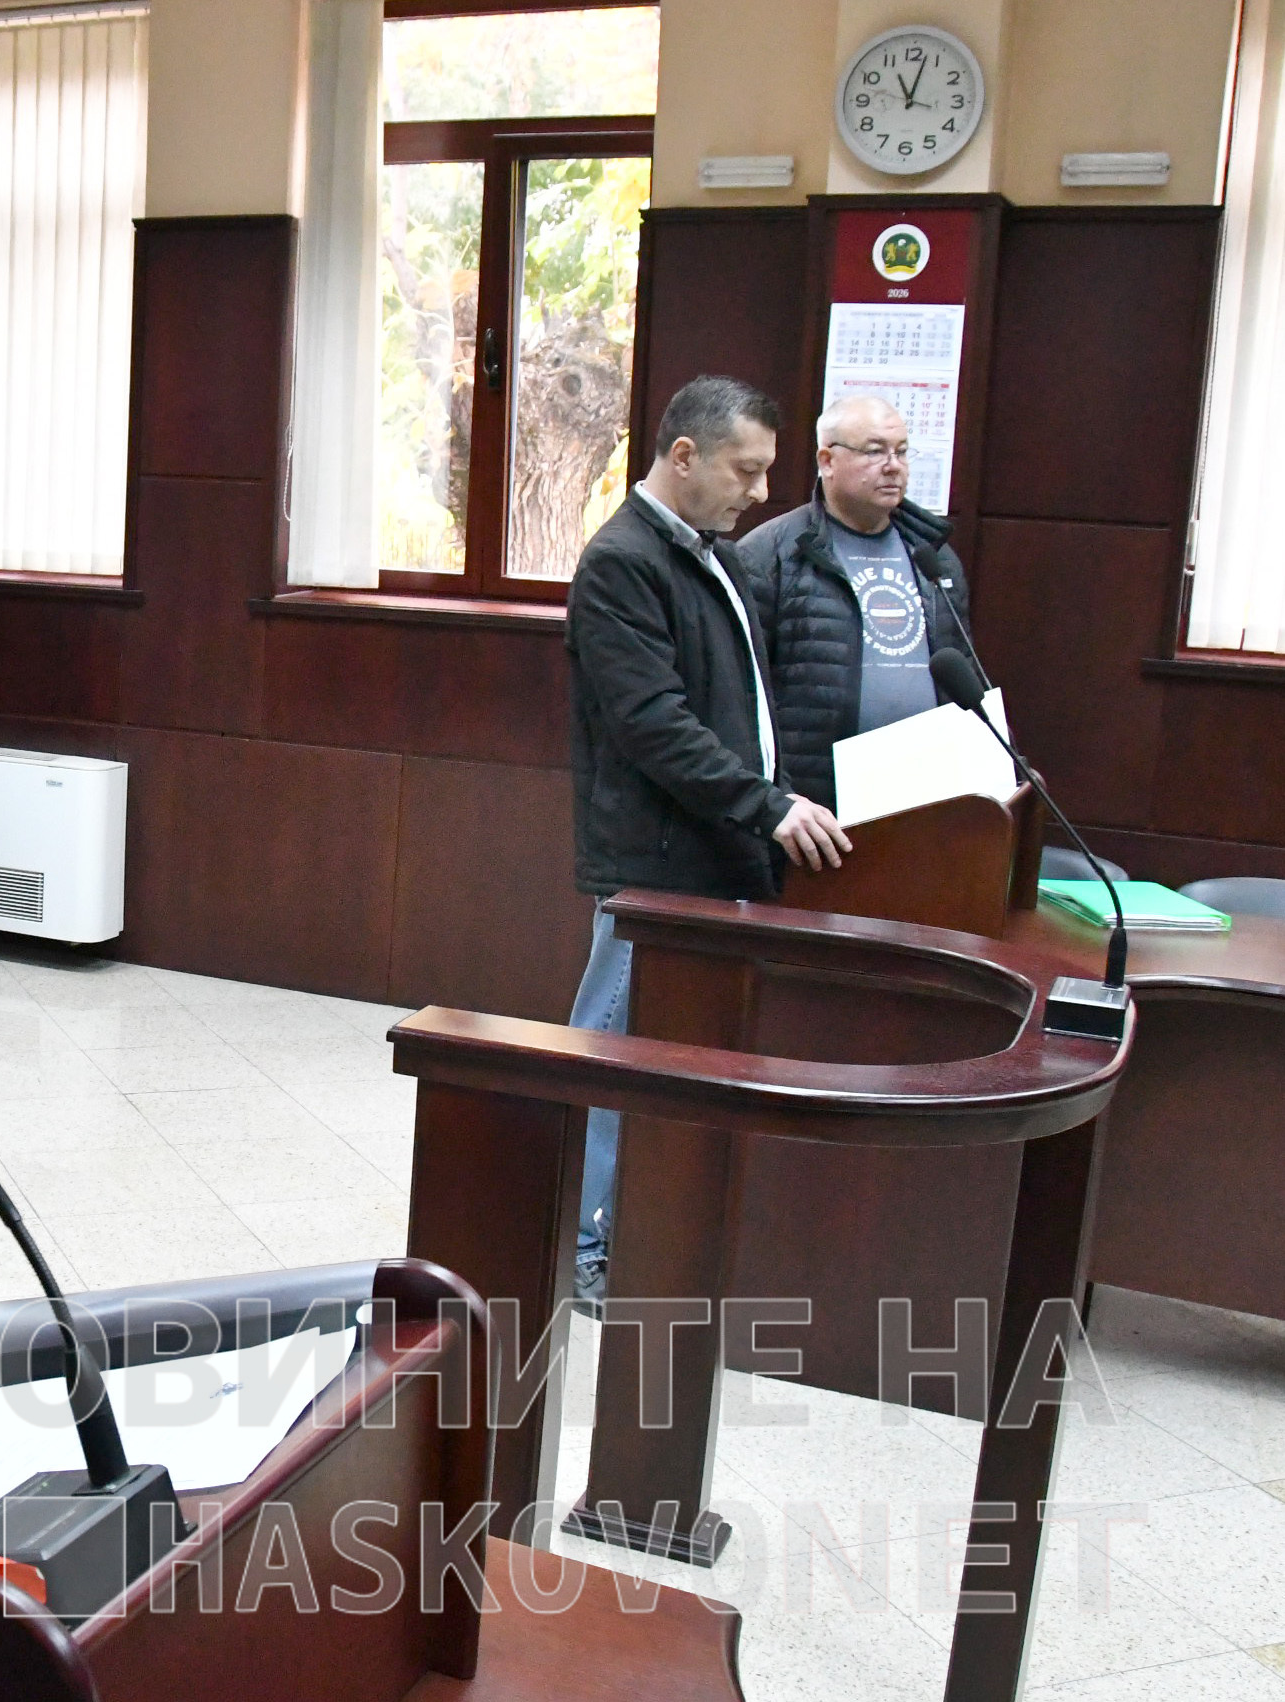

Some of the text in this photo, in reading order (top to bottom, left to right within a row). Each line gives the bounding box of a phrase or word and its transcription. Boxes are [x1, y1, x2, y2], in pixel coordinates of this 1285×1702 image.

[884, 54, 896, 68] 11
[905, 47, 923, 61] 12
[863, 71, 880, 85] 10
[946, 71, 960, 86] 2
[855, 94, 870, 108] 9
[951, 94, 964, 109] 3
[860, 116, 874, 132] 8
[941, 117, 955, 132] 4
[876, 134, 890, 149] 7
[898, 141, 913, 155] 6
[922, 135, 937, 149] 5
